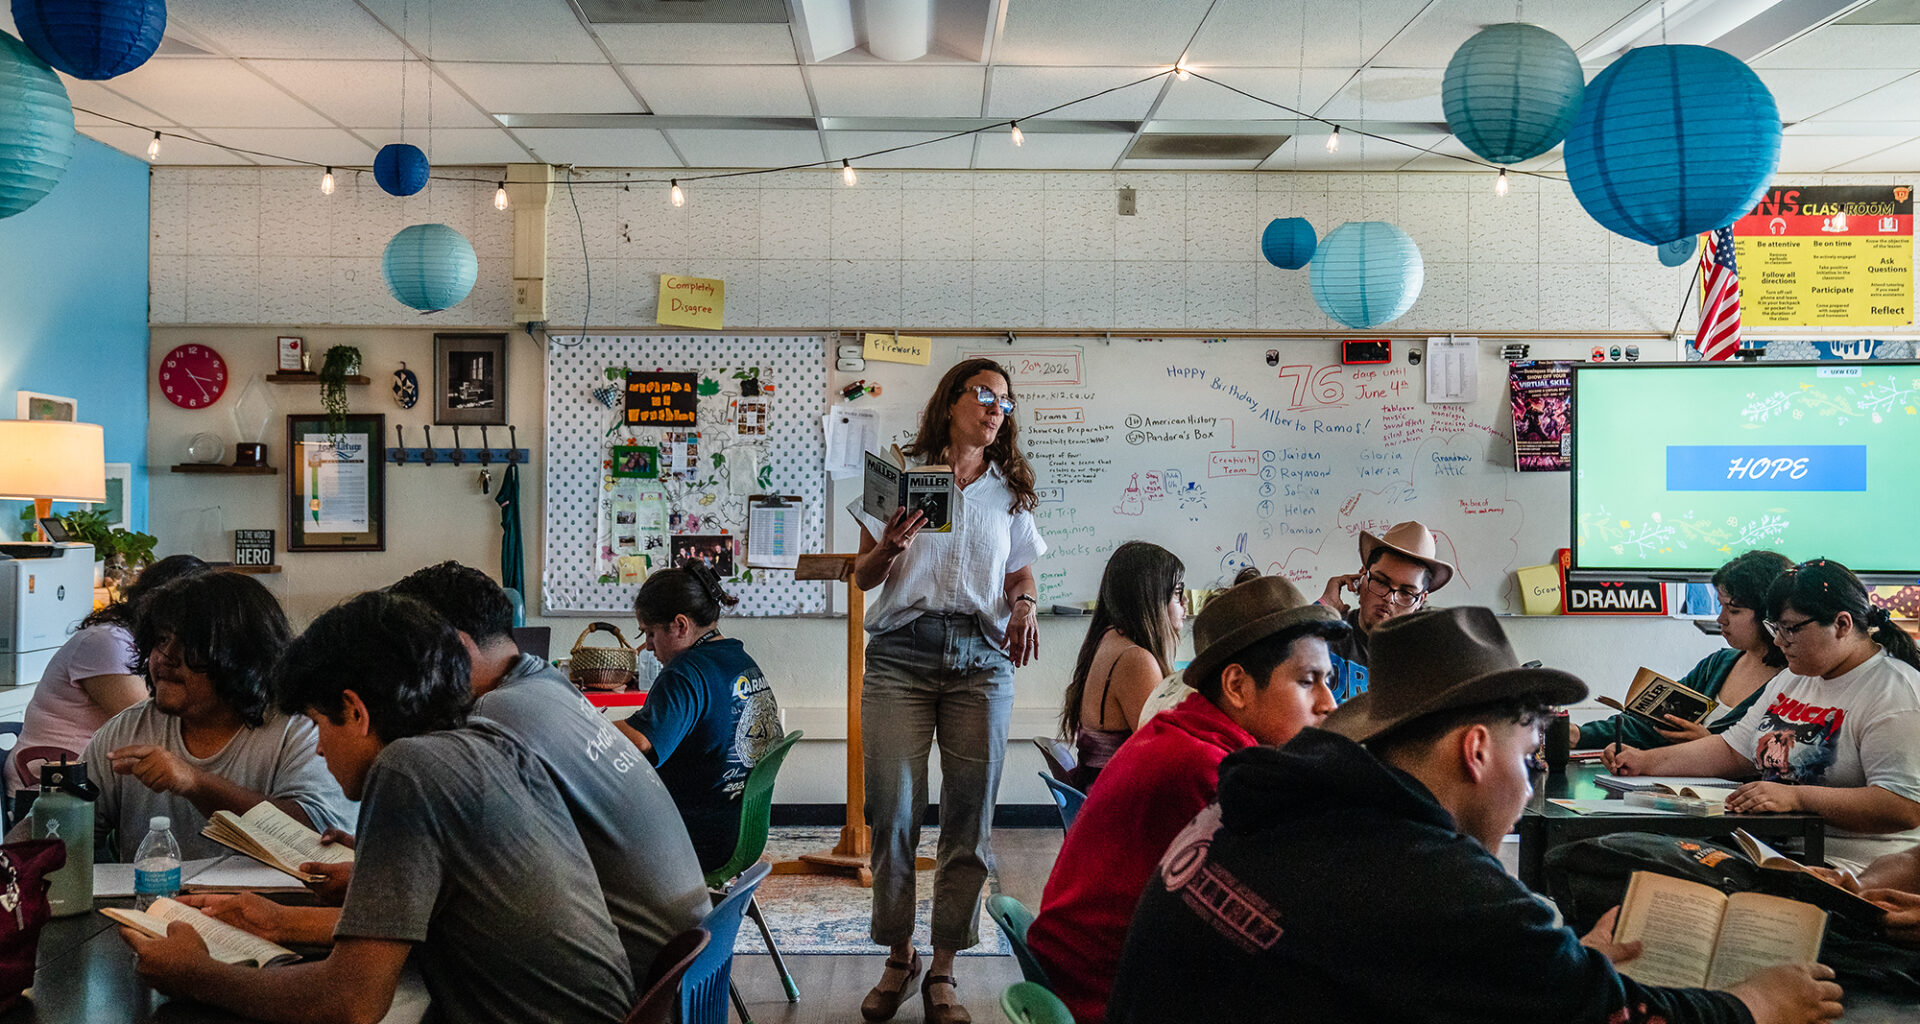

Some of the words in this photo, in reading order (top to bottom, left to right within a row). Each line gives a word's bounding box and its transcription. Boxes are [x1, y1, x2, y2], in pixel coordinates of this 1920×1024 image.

[1756, 190, 1800, 216] NS
[1802, 201, 1895, 216] CLASROOM
[1867, 266, 1908, 274] Questions
[667, 277, 715, 297] Completely
[1811, 286, 1854, 295] Participate
[671, 299, 713, 315] Disagree
[1871, 306, 1905, 315] Reflect
[188, 346, 198, 355] 12
[873, 338, 921, 356] Fireworks
[167, 360, 177, 369] 10
[1043, 362, 1070, 376] 2026
[1166, 364, 1206, 380] Happy
[1352, 368, 1378, 382] days
[1382, 367, 1407, 377] until
[1278, 364, 1345, 407] 76
[1355, 384, 1388, 400] June
[1390, 380, 1409, 397] 4th
[1519, 380, 1549, 389] VIRTUAL
[1035, 411, 1068, 422] Drama
[1144, 416, 1186, 428] American
[1187, 414, 1217, 428] History
[1259, 408, 1306, 432] Alberto
[1146, 430, 1191, 443] Pandora's
[1194, 429, 1215, 440] Box
[1212, 455, 1256, 465] Creativity
[1279, 447, 1321, 461] Jaiden
[1360, 449, 1403, 460] Gloria
[867, 459, 898, 484] MILLER
[1223, 466, 1247, 474] Team
[1280, 465, 1332, 482] Raymond
[1434, 464, 1465, 476] Attic
[1726, 457, 1810, 480] HOPE
[910, 477, 949, 487] MILLER
[1033, 508, 1052, 519] ield
[1055, 507, 1076, 523] Trip
[1285, 504, 1316, 517] Helen
[1345, 519, 1377, 535] SMILE
[236, 548, 270, 565] HERO
[1040, 543, 1091, 560] arbucks
[1571, 589, 1657, 609] DRAMA
[1635, 684, 1668, 713] MILLER
